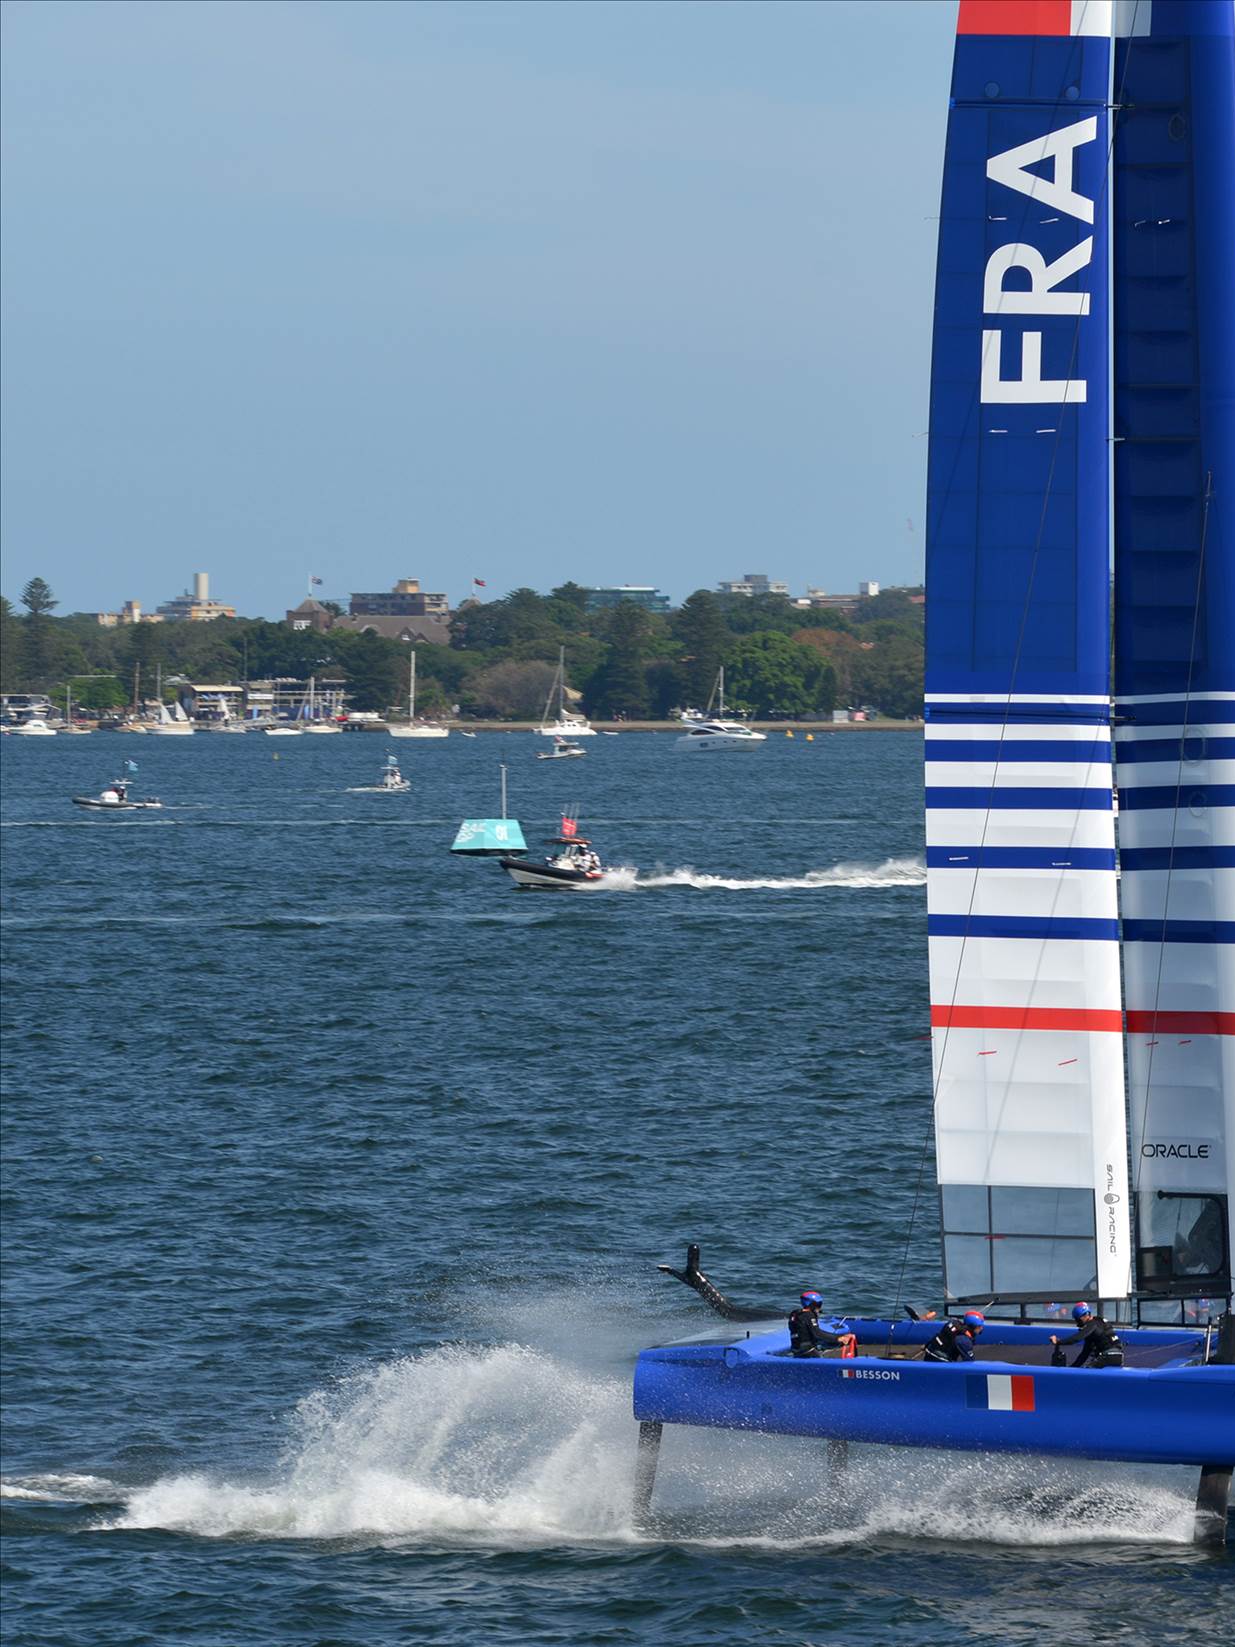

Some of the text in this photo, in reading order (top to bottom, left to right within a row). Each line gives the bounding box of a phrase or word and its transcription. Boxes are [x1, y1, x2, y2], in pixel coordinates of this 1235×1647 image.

[980, 115, 1098, 404] FRA
[1141, 1143, 1209, 1159] ORACLE
[1106, 1163, 1117, 1254] SAIL RACING
[855, 1369, 901, 1381] BESSON
